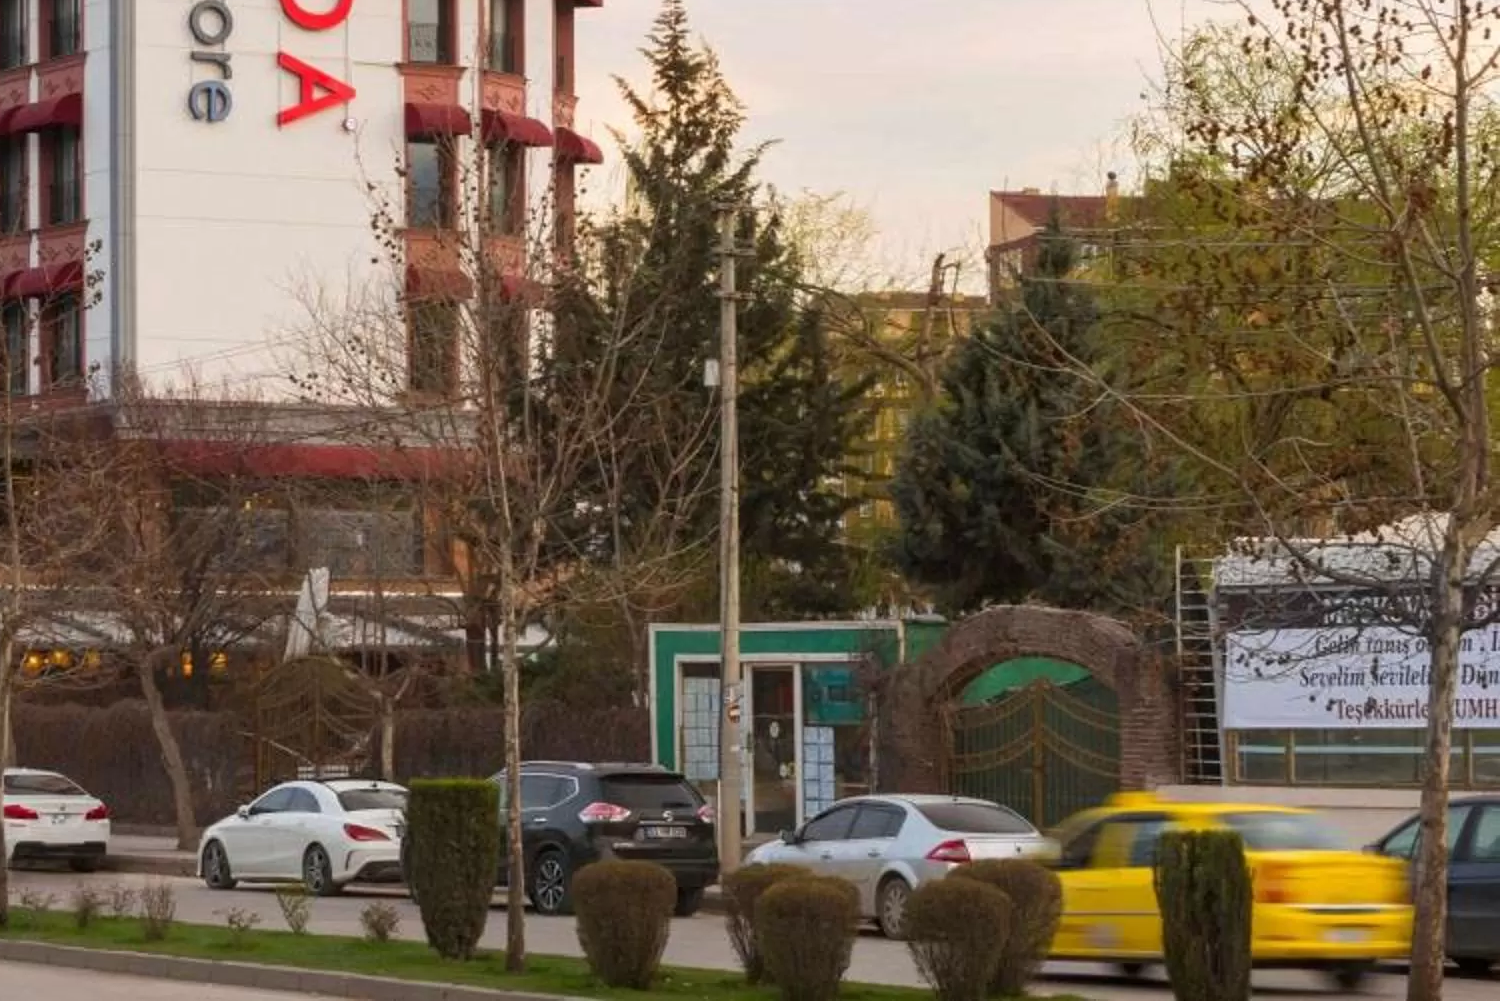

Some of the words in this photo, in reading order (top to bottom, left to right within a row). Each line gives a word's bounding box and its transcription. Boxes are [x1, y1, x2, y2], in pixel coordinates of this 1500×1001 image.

[1299, 664, 1366, 688] Sevelim
[1370, 663, 1433, 688] Sevileli
[1336, 696, 1431, 723] Teşekkürle
[1454, 698, 1498, 720] UMH
